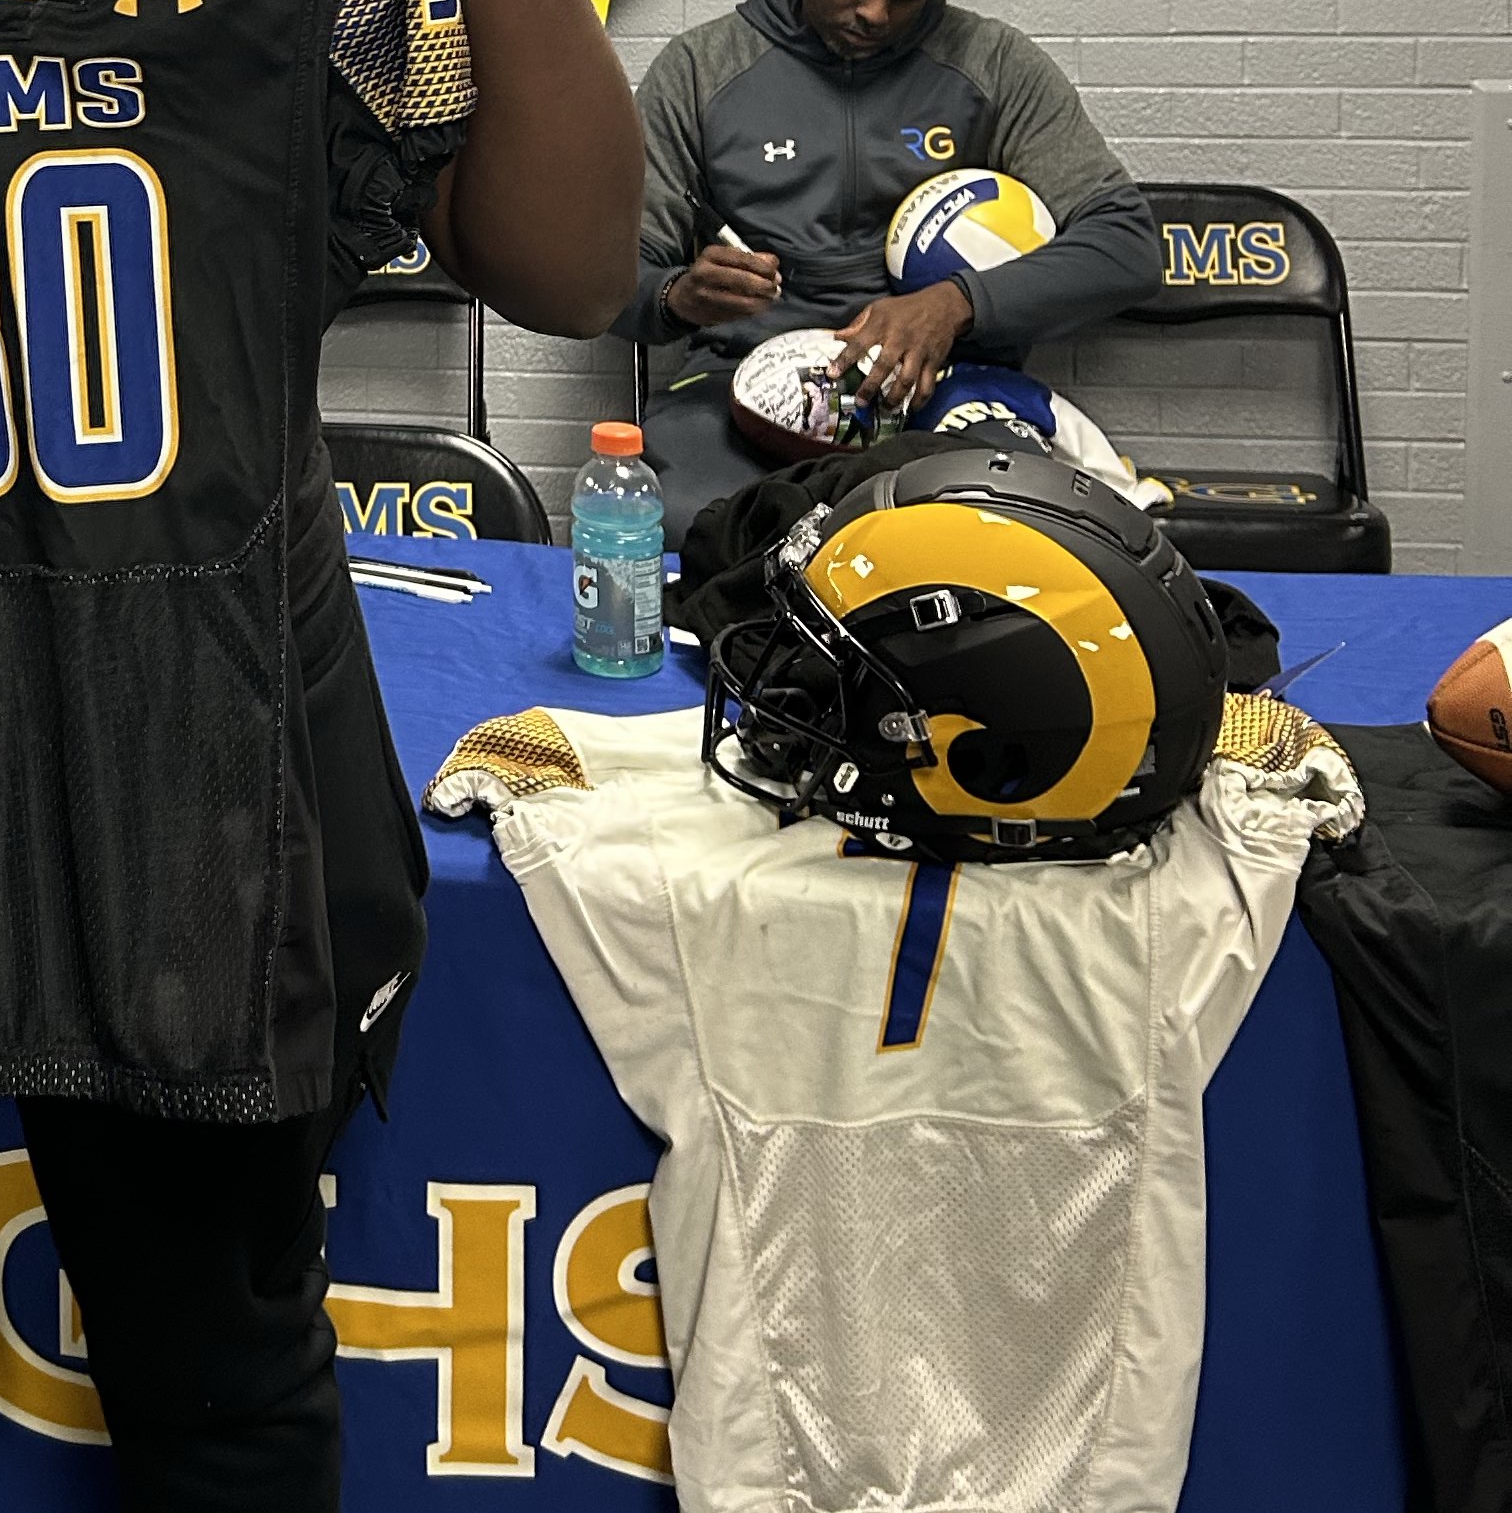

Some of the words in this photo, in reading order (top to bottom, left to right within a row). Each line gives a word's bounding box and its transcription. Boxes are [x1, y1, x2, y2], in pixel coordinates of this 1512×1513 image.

[899, 126, 955, 161] RG
[1162, 222, 1290, 285] MS
[334, 481, 478, 540] MS
[573, 564, 598, 609] G
[836, 811, 890, 830] schutt
